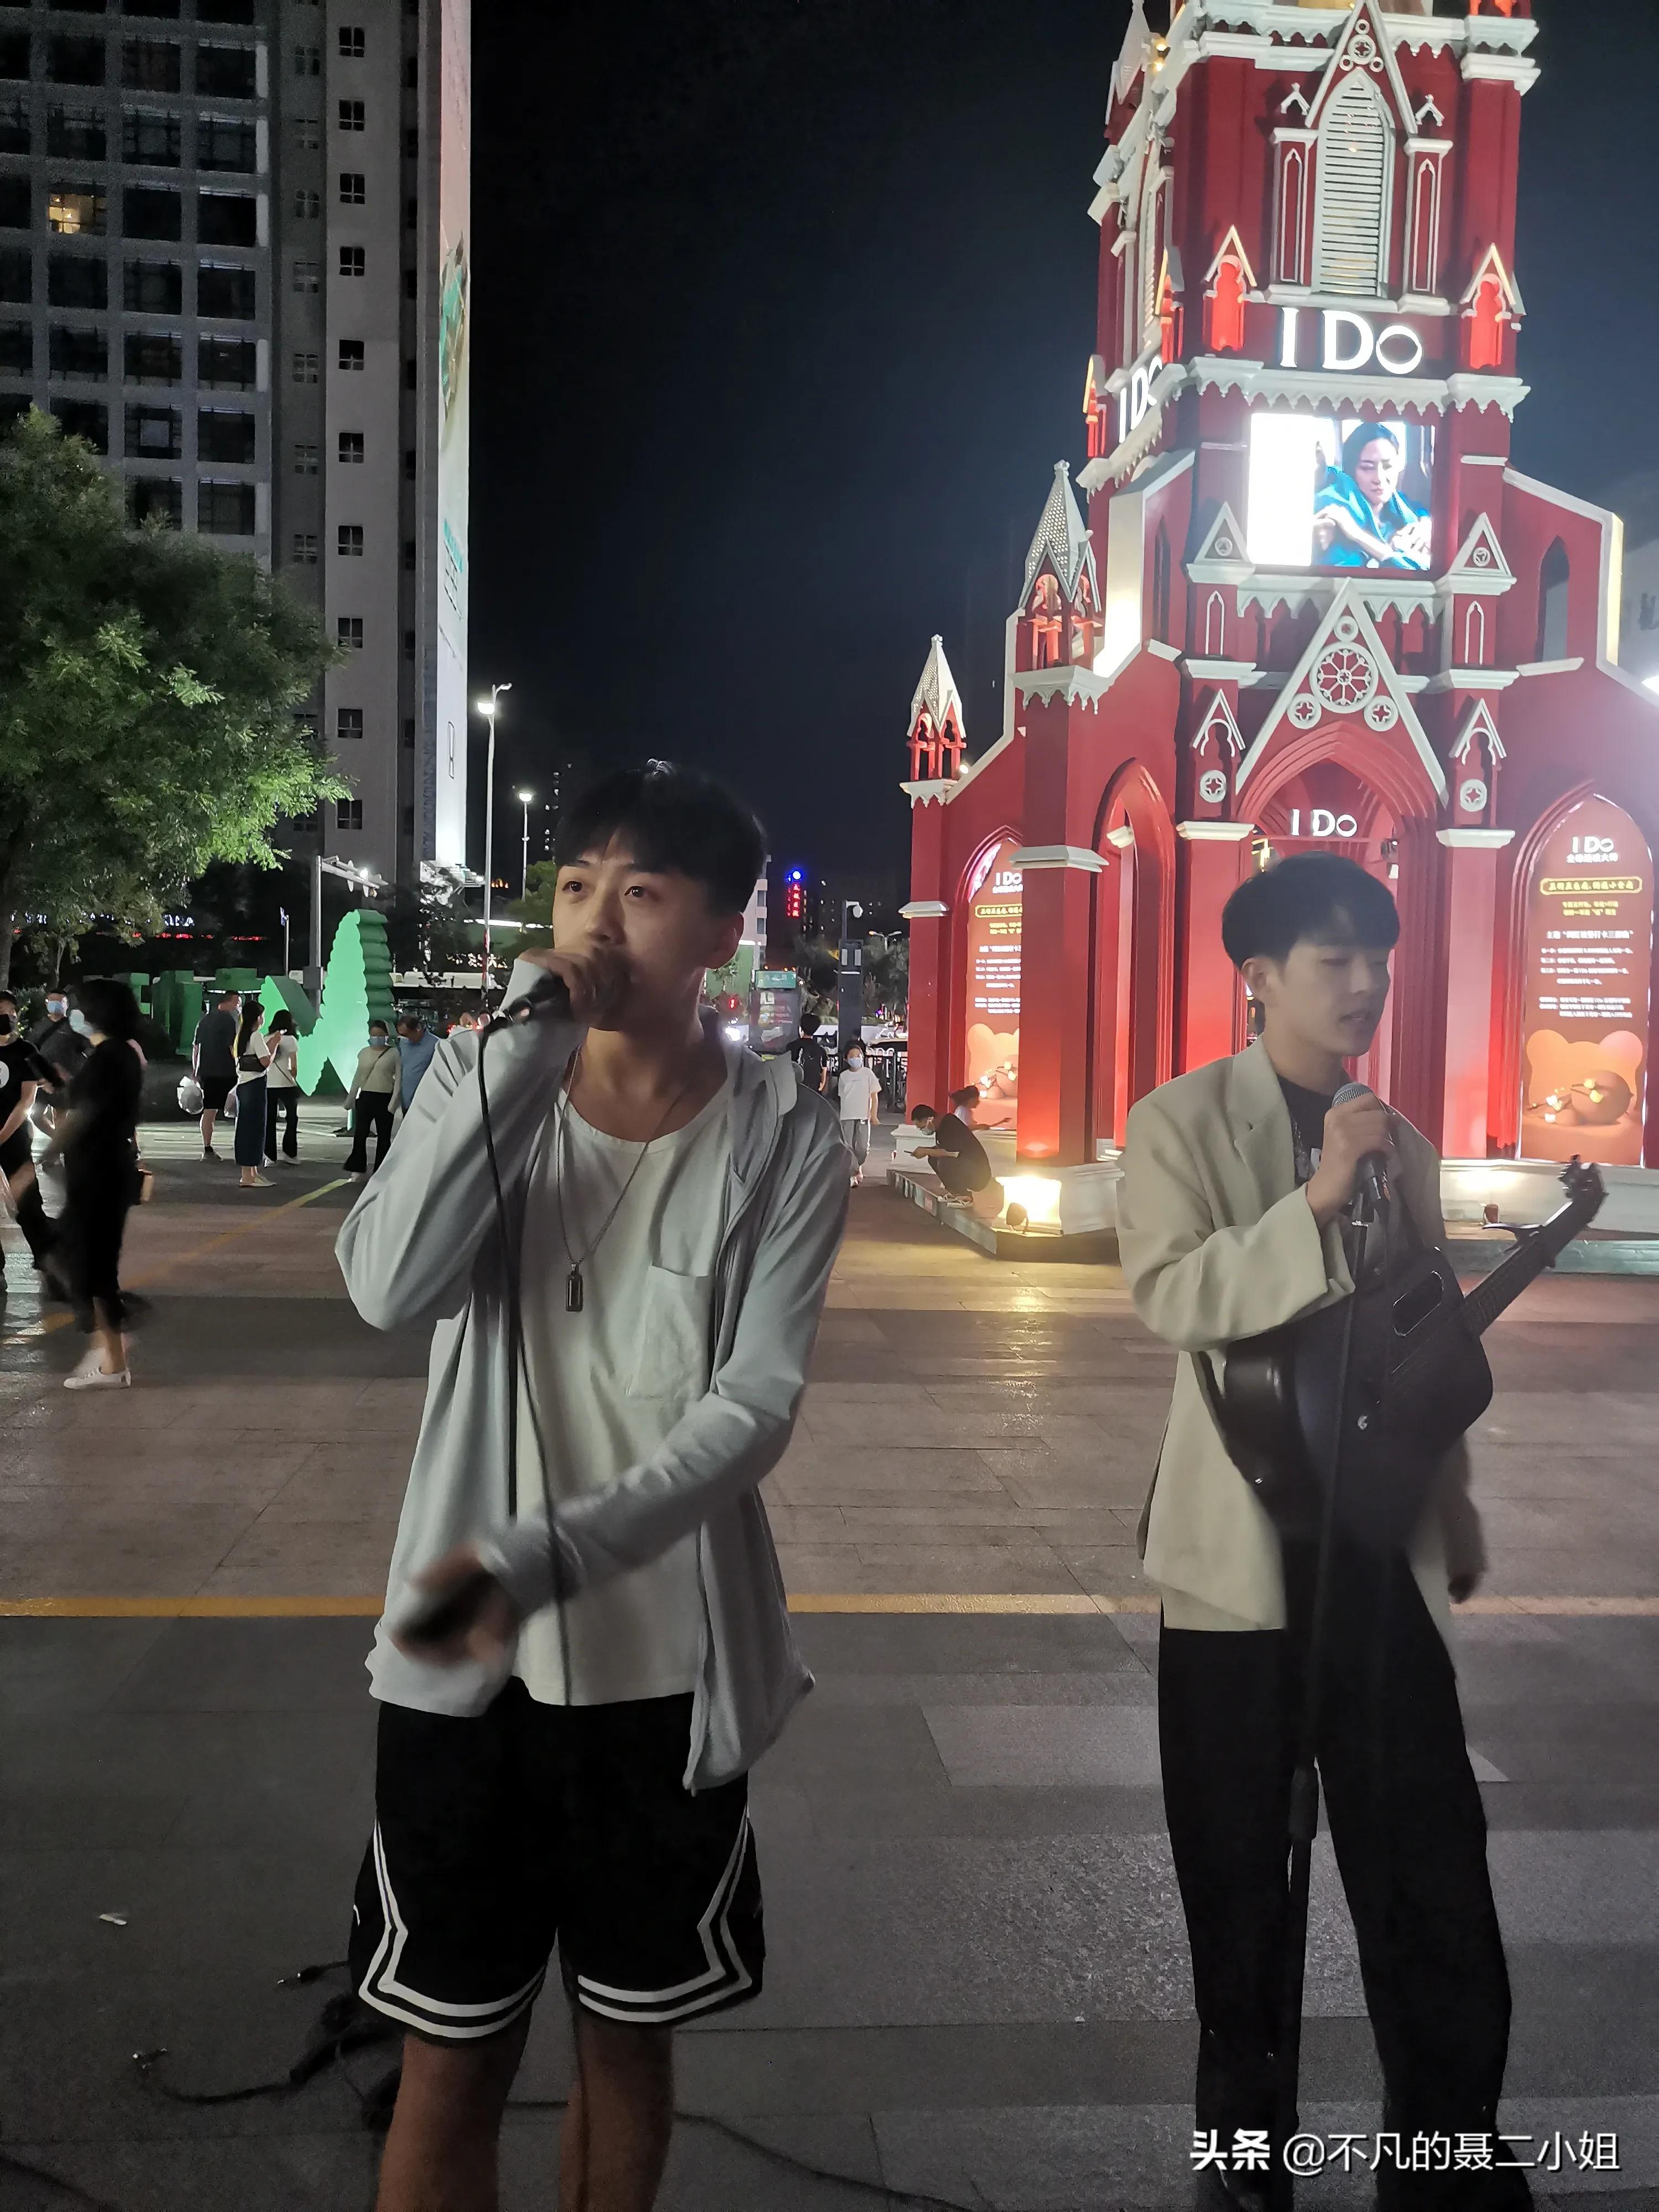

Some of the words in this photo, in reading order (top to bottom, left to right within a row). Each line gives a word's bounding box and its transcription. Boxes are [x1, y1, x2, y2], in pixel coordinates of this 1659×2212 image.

[1280, 307, 1299, 368] I
[1119, 387, 1127, 444] I
[1291, 808, 1300, 836] I
[1572, 836, 1579, 853] I
[995, 872, 1001, 886] I
